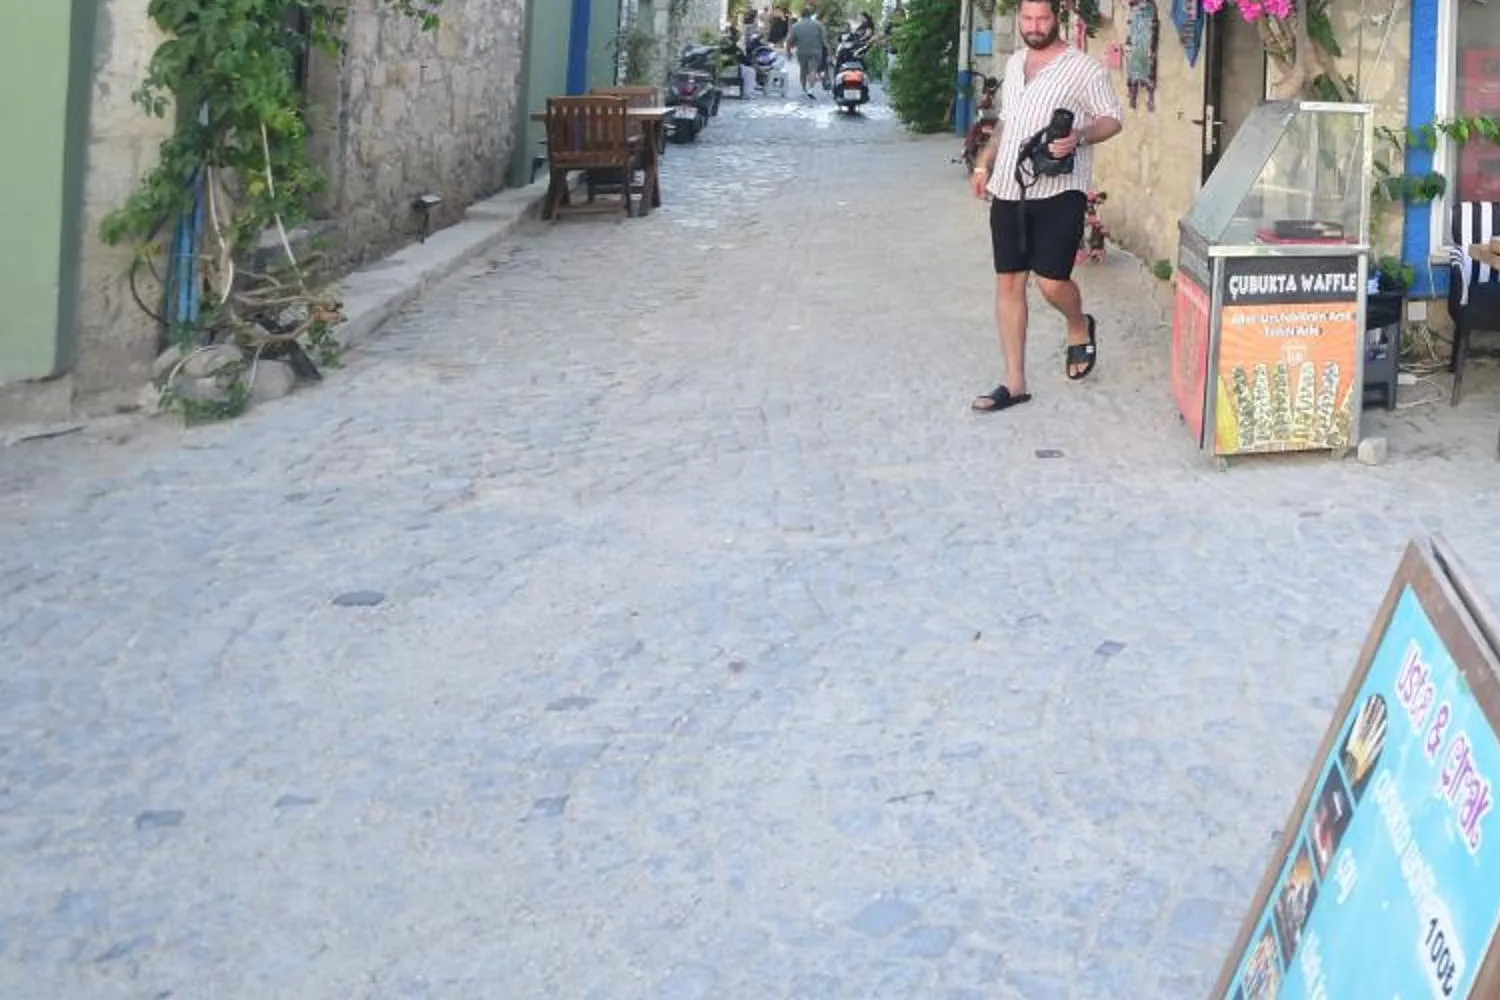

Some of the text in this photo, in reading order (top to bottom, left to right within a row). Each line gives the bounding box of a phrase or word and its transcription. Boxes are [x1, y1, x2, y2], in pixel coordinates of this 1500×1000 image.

[1229, 273, 1358, 300] ÇUBUKTA WAFFLE
[1426, 702, 1450, 763] &
